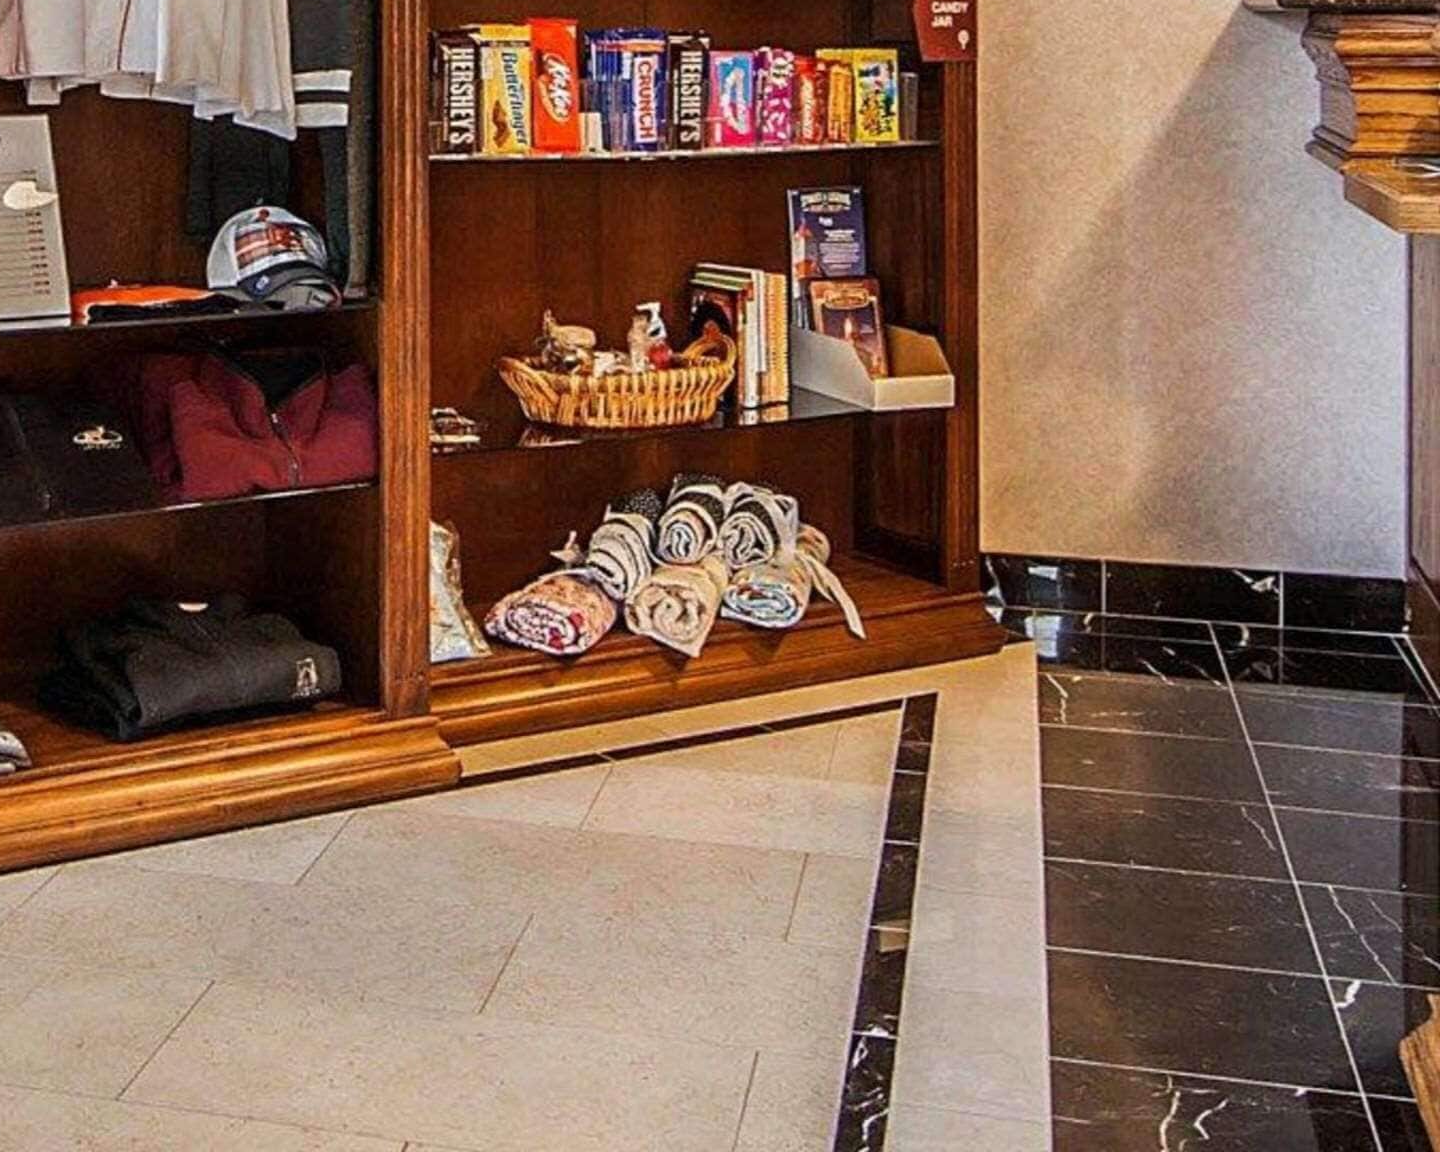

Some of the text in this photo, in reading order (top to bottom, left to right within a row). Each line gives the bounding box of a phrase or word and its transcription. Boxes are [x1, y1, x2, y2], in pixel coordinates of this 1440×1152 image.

[931, 1, 969, 14] CANDY
[449, 47, 475, 145] HERSHEY'S
[501, 51, 528, 146] Butterfinger
[637, 60, 656, 140] CRUNCH
[680, 50, 703, 143] HERSHEY'S
